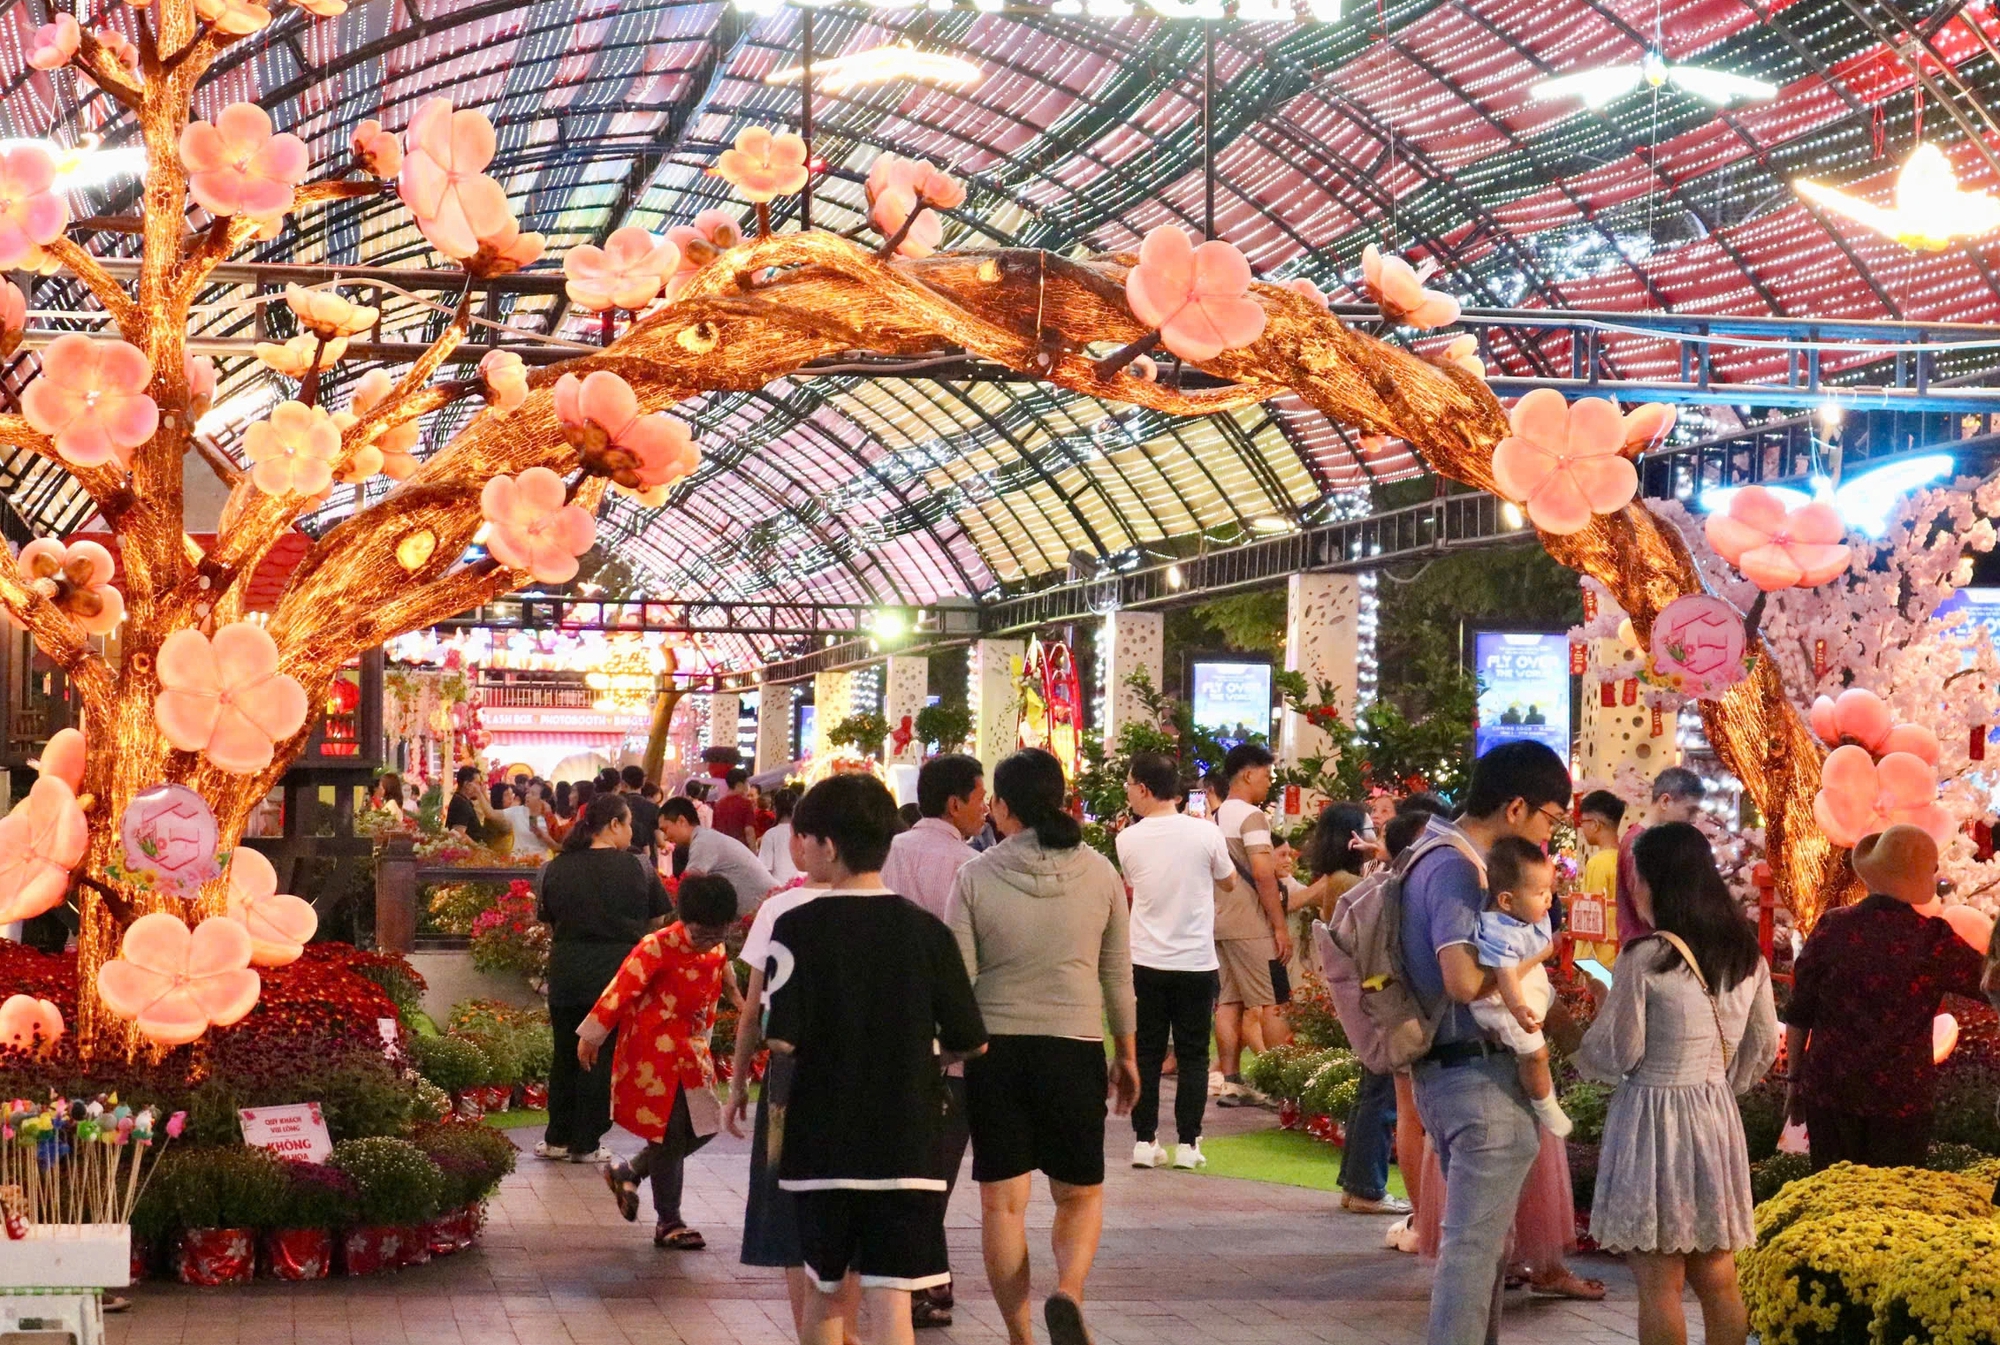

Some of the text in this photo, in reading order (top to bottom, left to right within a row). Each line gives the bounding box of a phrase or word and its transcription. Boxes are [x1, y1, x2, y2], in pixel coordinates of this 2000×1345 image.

[1487, 655, 1513, 668] FLY
[540, 715, 606, 727] PHOTOBOOTH
[267, 1139, 311, 1152] KHÔNG
